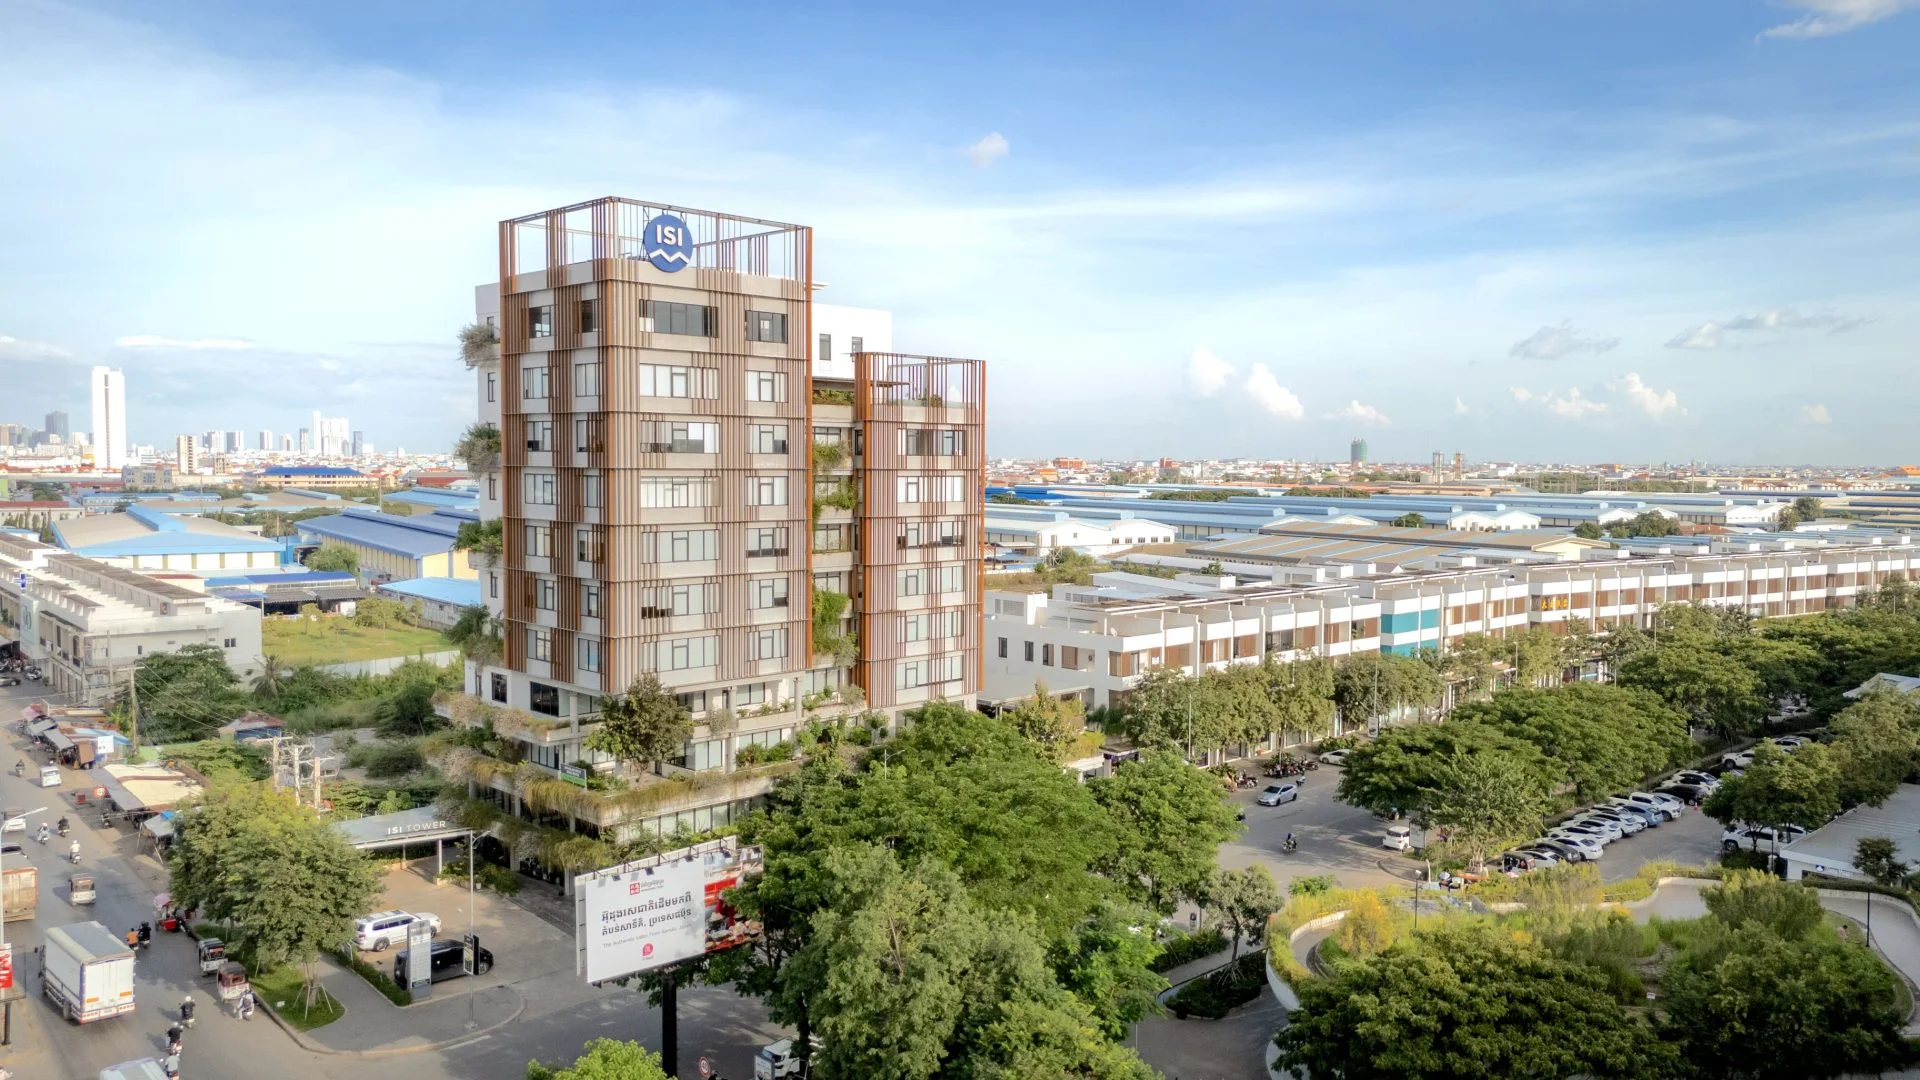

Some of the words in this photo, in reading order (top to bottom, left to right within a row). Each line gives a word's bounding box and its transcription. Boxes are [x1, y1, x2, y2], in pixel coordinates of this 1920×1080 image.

[656, 224, 683, 247] ISI
[387, 826, 403, 835] ISI
[407, 820, 446, 832] TOWER
